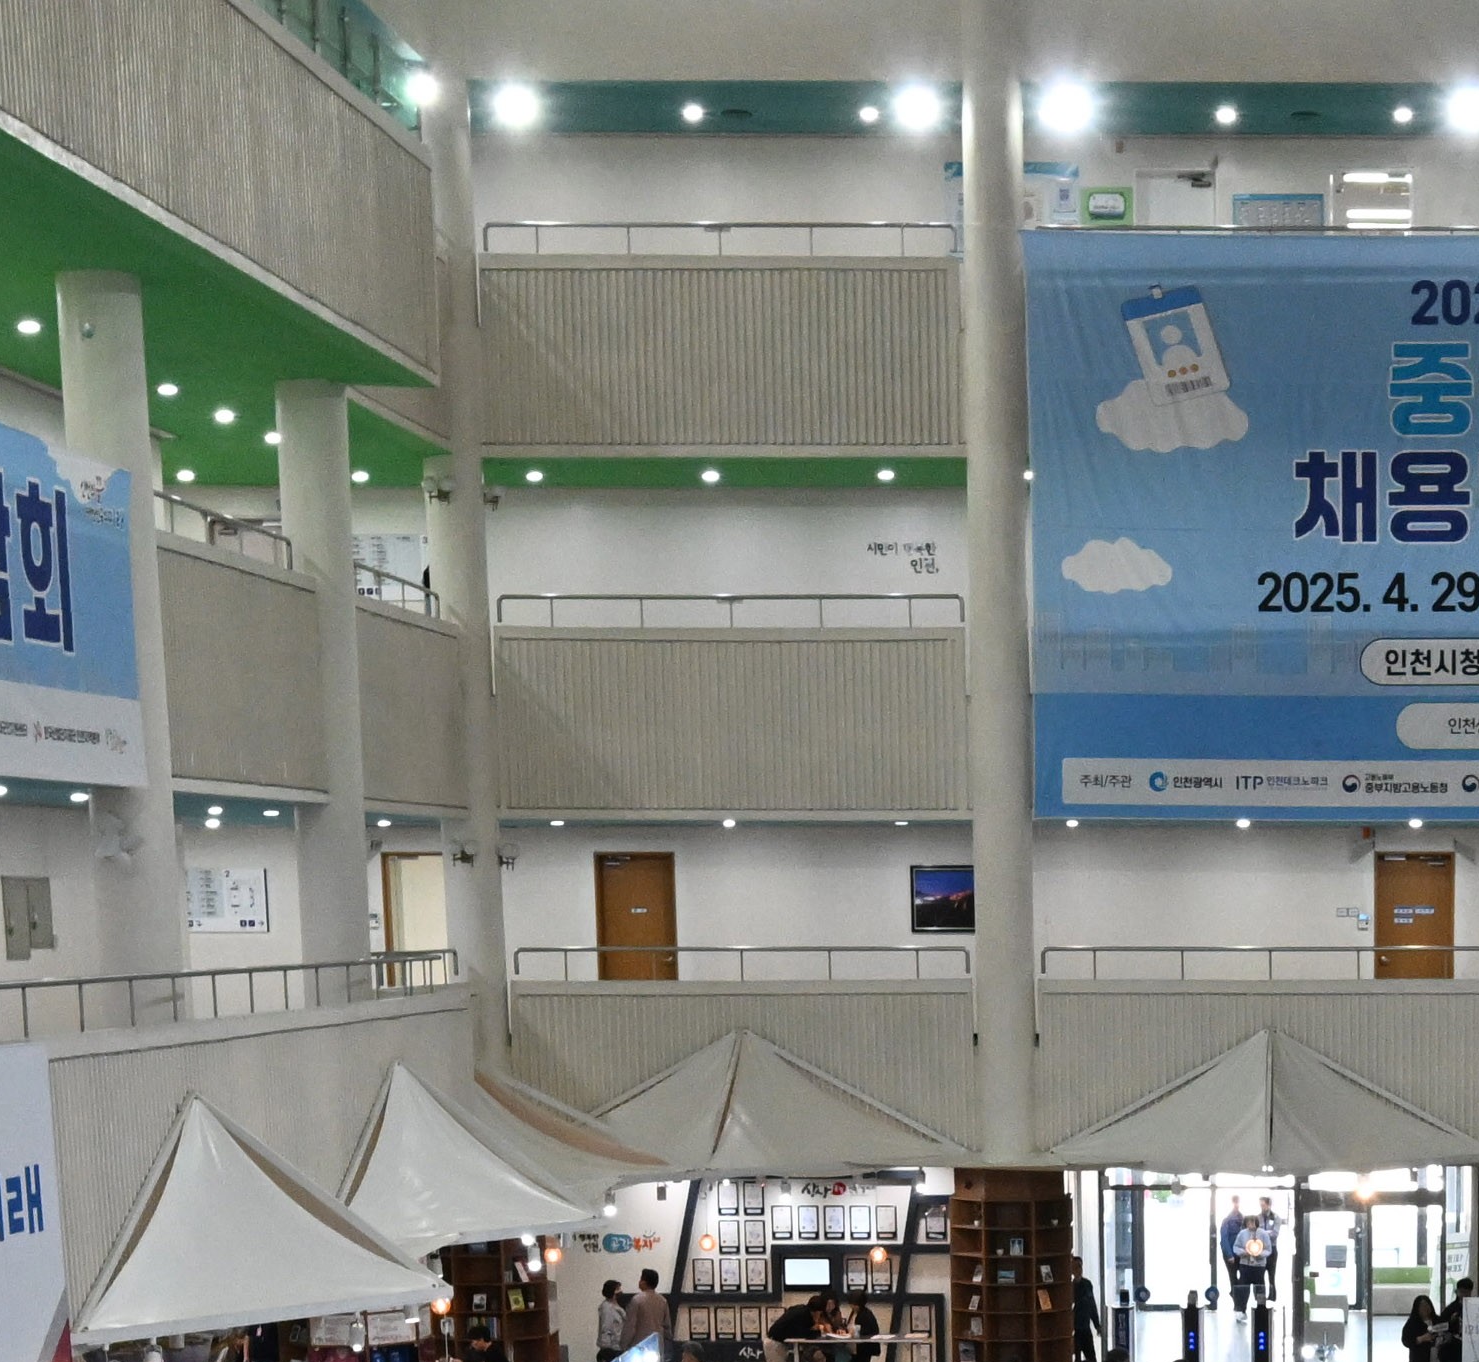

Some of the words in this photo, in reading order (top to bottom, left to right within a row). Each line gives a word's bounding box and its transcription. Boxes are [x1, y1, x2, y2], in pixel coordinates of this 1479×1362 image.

[1257, 571, 1371, 614] 2025.
[1079, 773, 1133, 789] 주최/주관
[1172, 776, 1223, 789] 인천광역시
[1236, 776, 1264, 790] ITP
